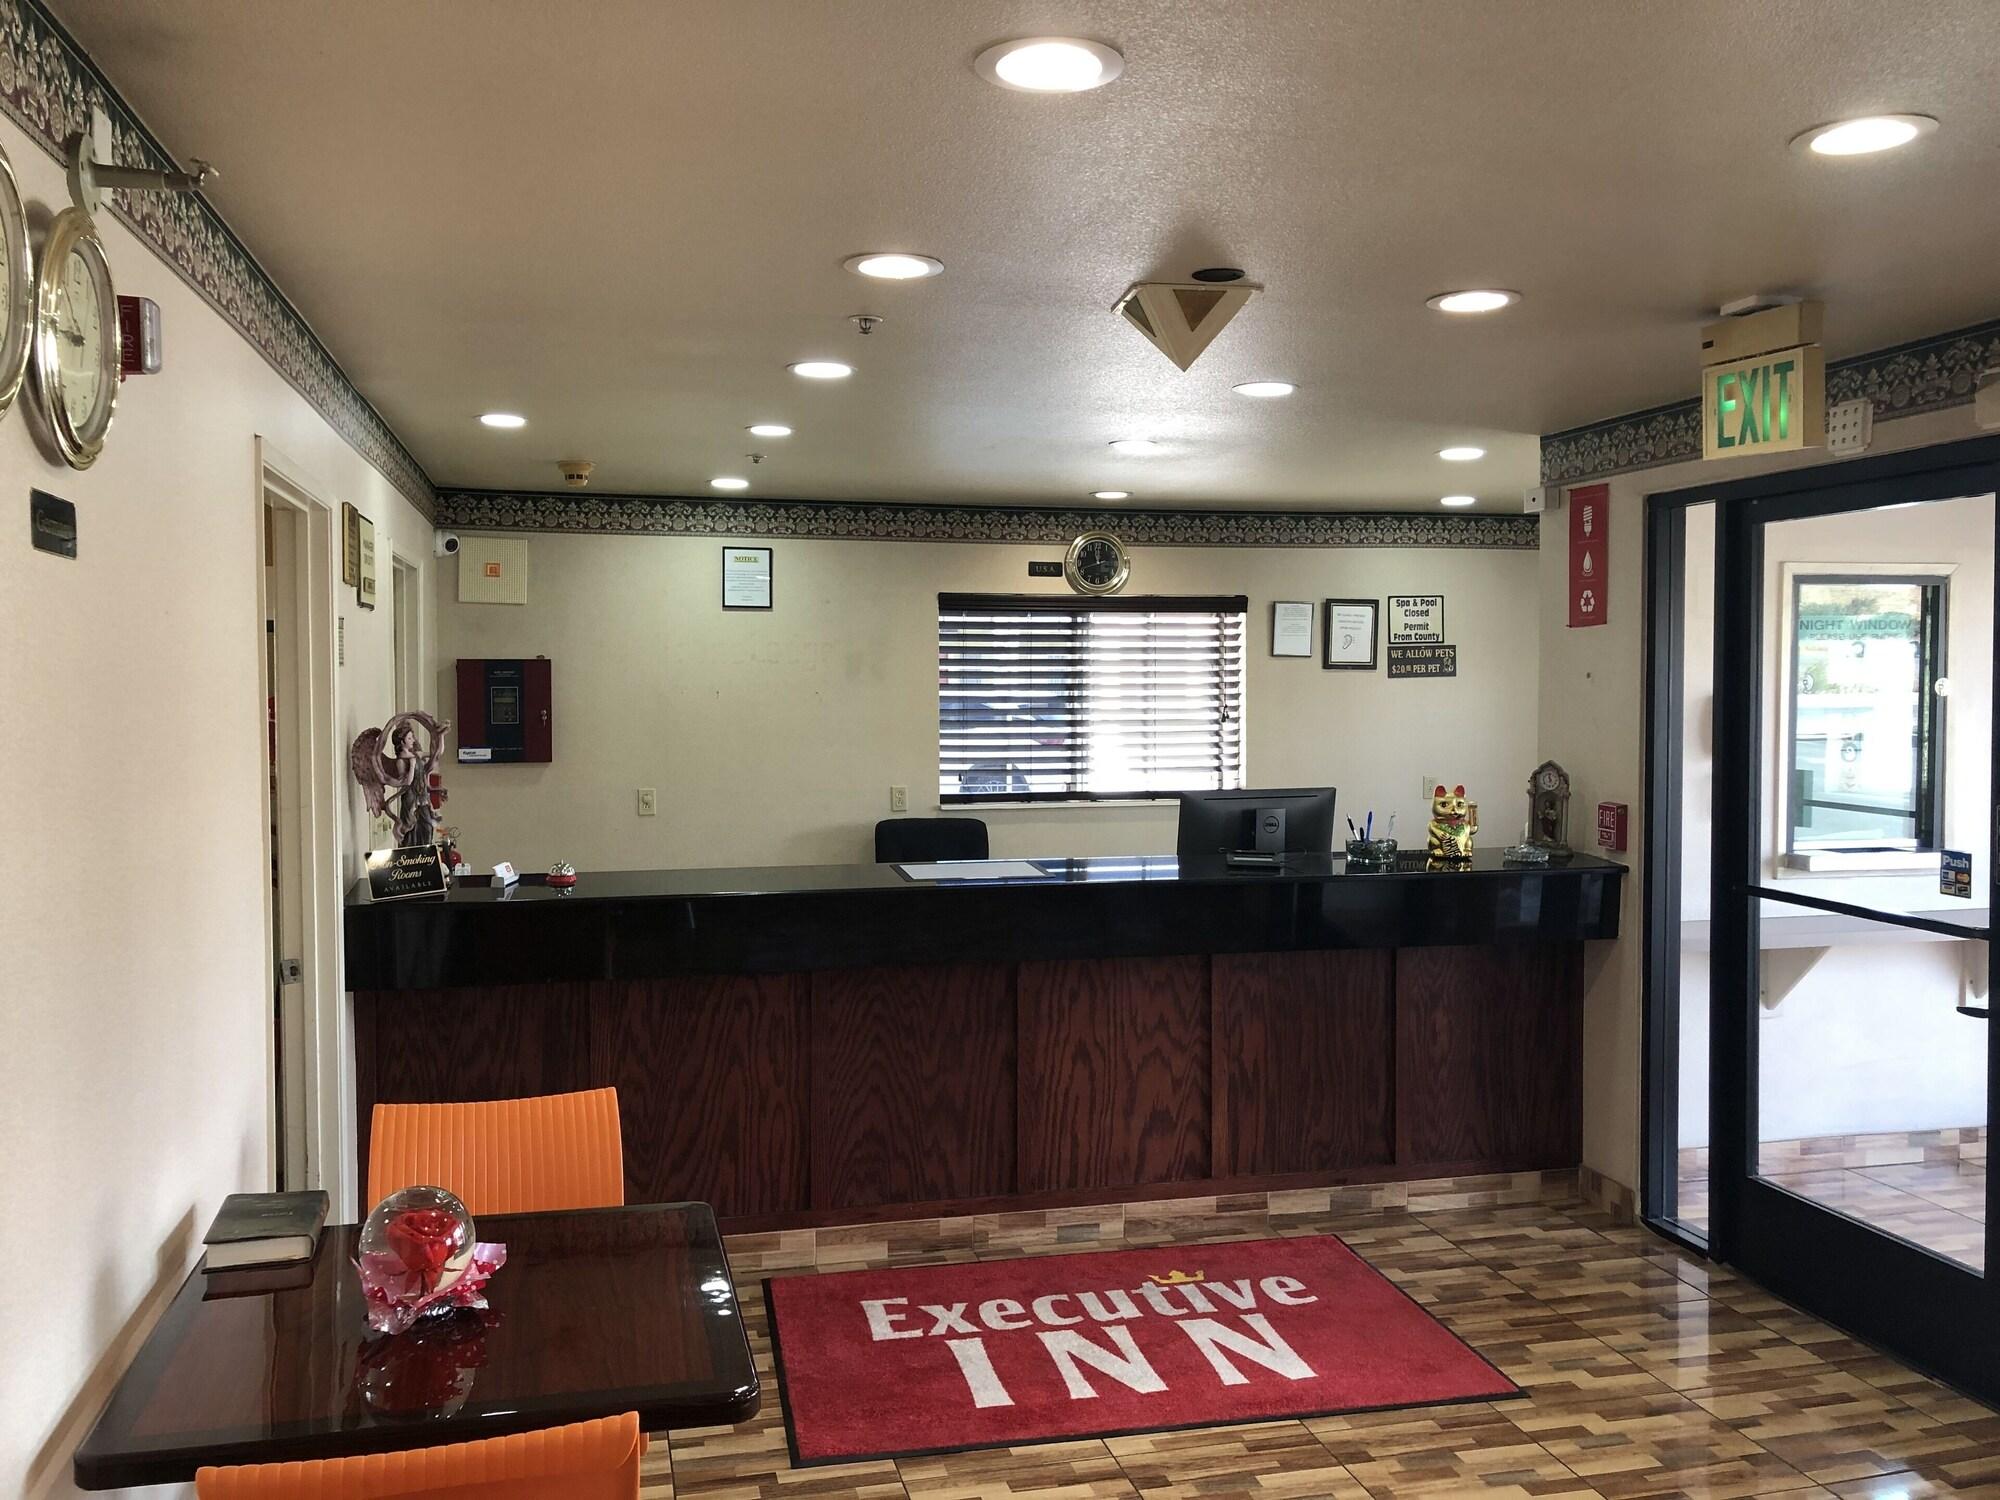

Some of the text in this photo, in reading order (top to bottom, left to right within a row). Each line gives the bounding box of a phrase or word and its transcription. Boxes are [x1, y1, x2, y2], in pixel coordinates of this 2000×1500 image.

[119, 304, 135, 362] FIRE
[1717, 360, 1795, 448] EXIT
[1035, 565, 1056, 573] USA
[1396, 598, 1437, 608] Spa & Pool
[1404, 609, 1429, 617] Closed
[1404, 622, 1429, 631] Permit
[1800, 619, 1912, 630] NIGHT WINDOW
[1394, 632, 1440, 642] From County
[1391, 649, 1454, 658] WE ALLOW PETS
[1413, 664, 1425, 673] PER
[1428, 664, 1440, 673] PET
[1599, 809, 1615, 828] FIRE
[1943, 855, 1969, 869] Push
[389, 868, 422, 881] Rooms
[860, 1275, 1318, 1342] Executive
[946, 1313, 1318, 1408] INN
